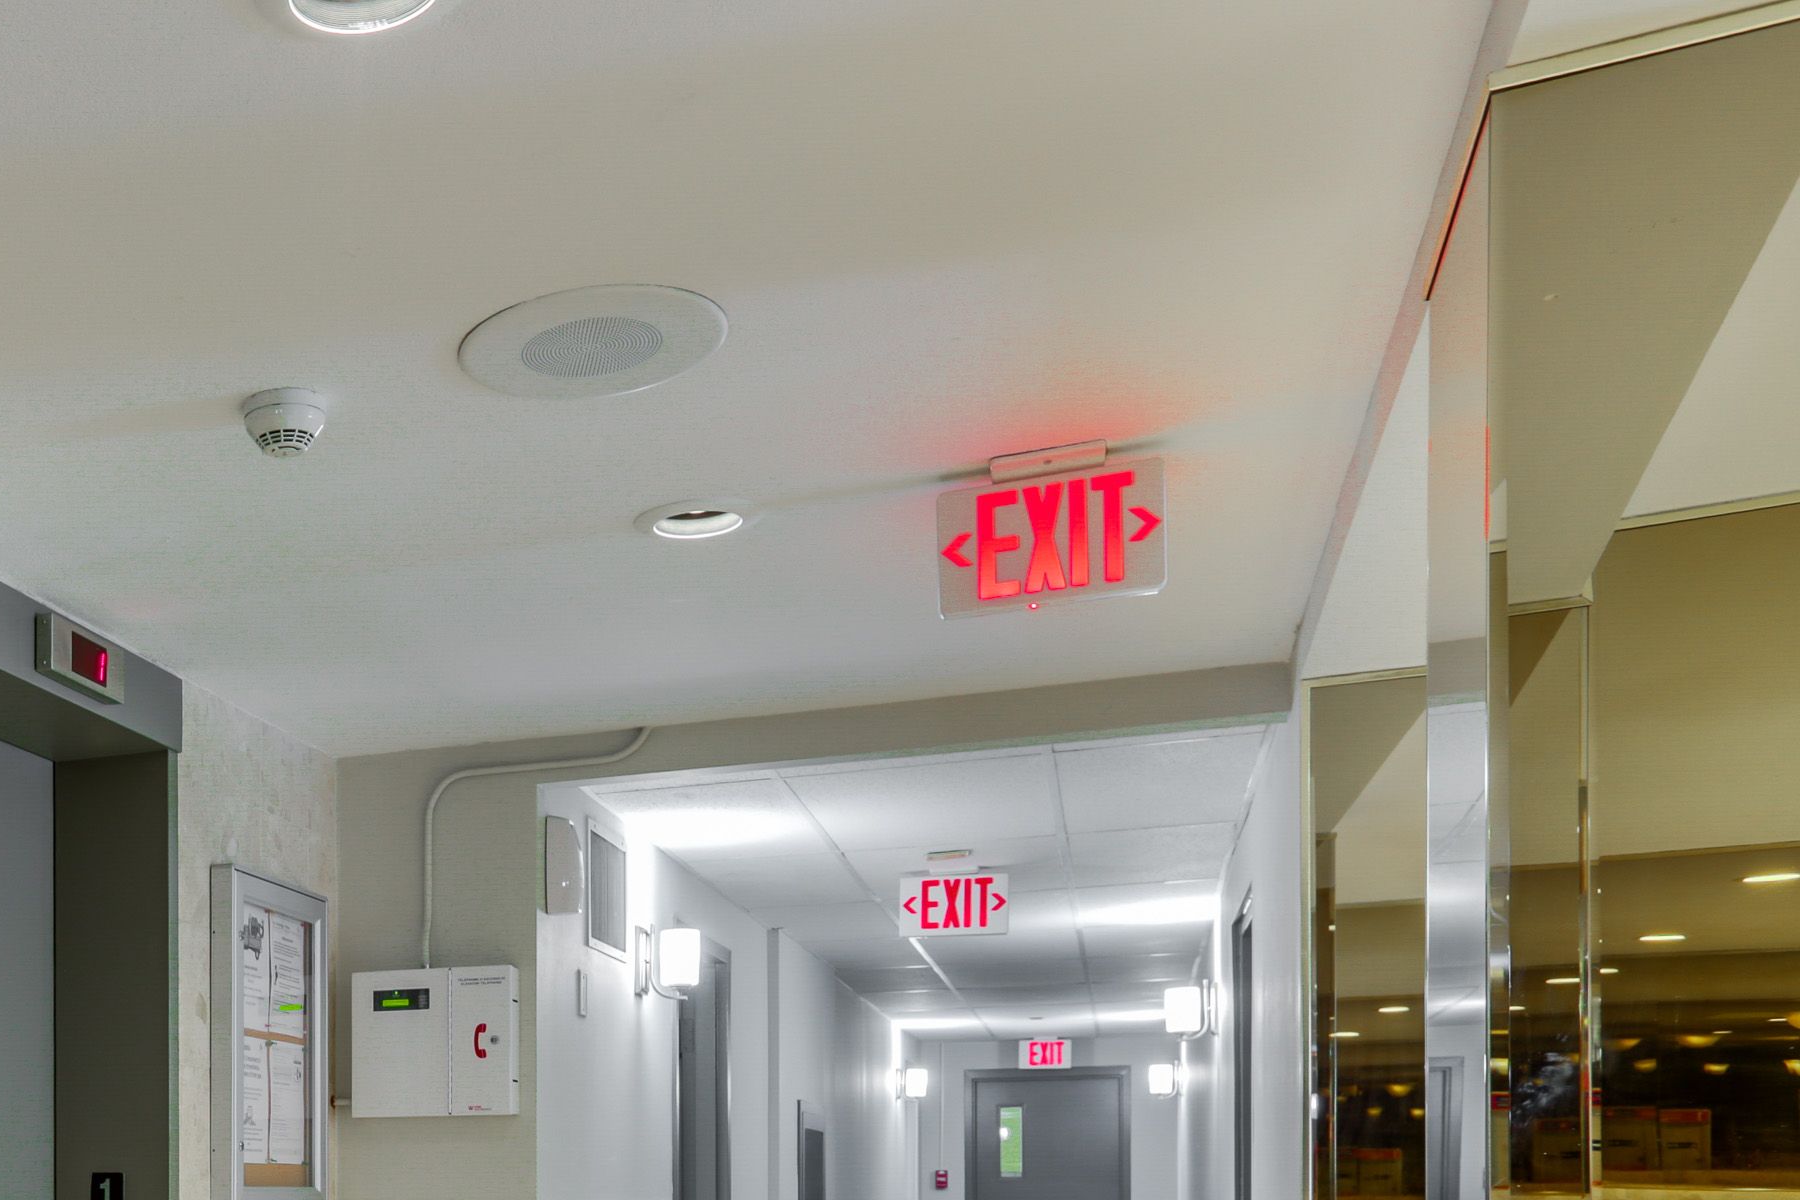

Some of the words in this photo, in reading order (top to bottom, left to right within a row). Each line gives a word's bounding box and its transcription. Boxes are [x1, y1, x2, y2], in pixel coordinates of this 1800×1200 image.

[976, 470, 1135, 601] EXIT
[921, 877, 994, 929] EXIT
[1029, 1041, 1064, 1066] EXIT
